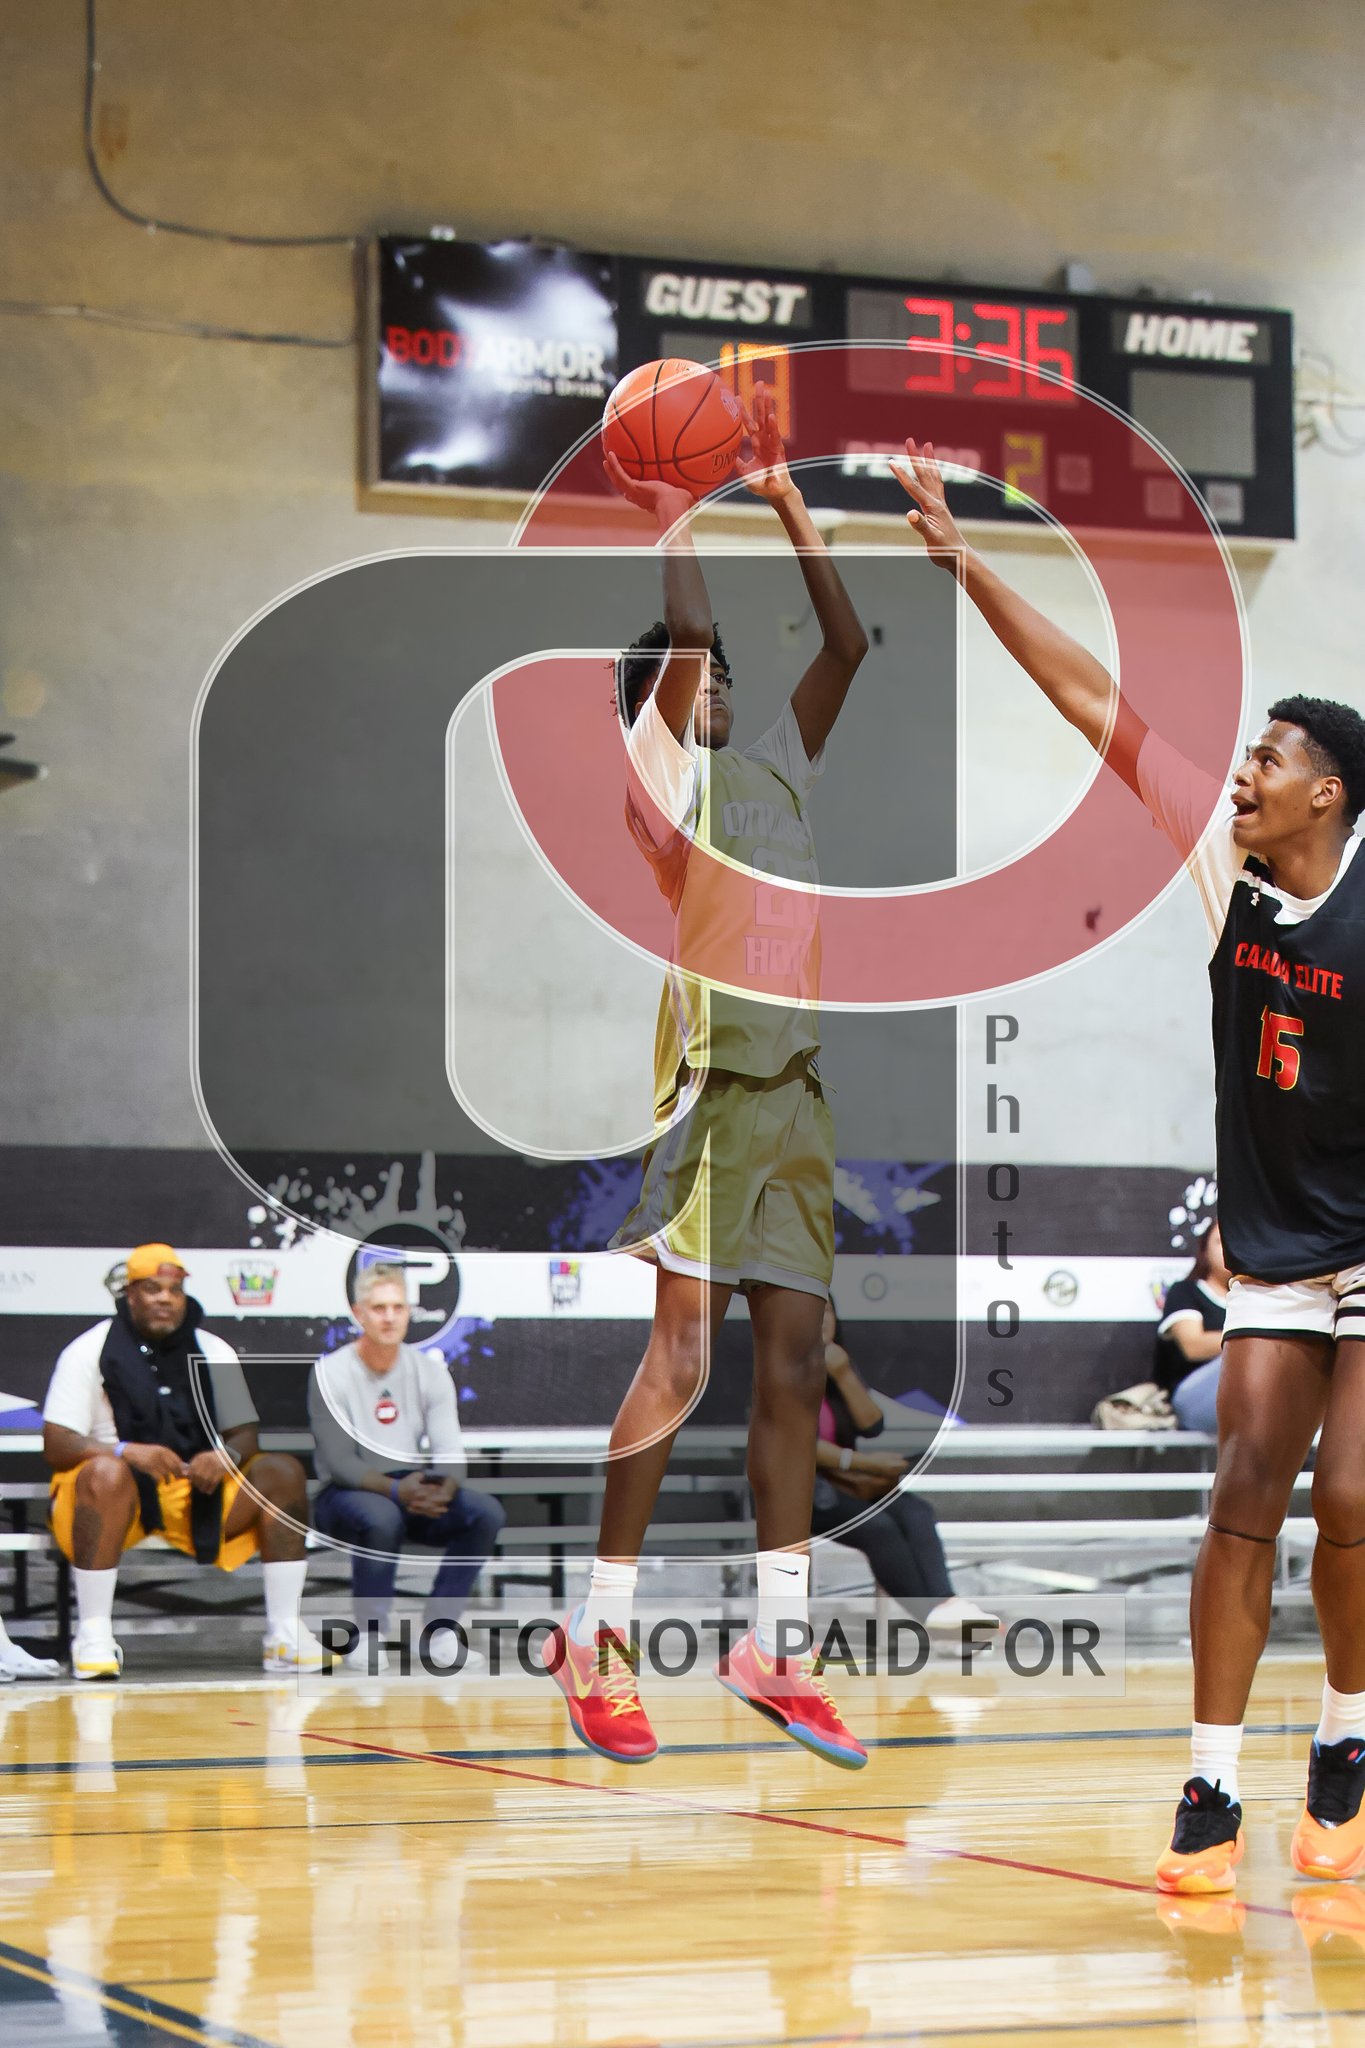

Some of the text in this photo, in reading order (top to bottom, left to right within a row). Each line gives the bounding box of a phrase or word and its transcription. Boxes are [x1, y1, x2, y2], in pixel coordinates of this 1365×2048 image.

[645, 273, 808, 326] GUEST
[905, 297, 1075, 402] 3:36
[1124, 312, 1259, 364] HOME
[1004, 433, 1045, 505] 2
[1294, 963, 1344, 1001] ELITE
[1257, 1004, 1305, 1091] 15
